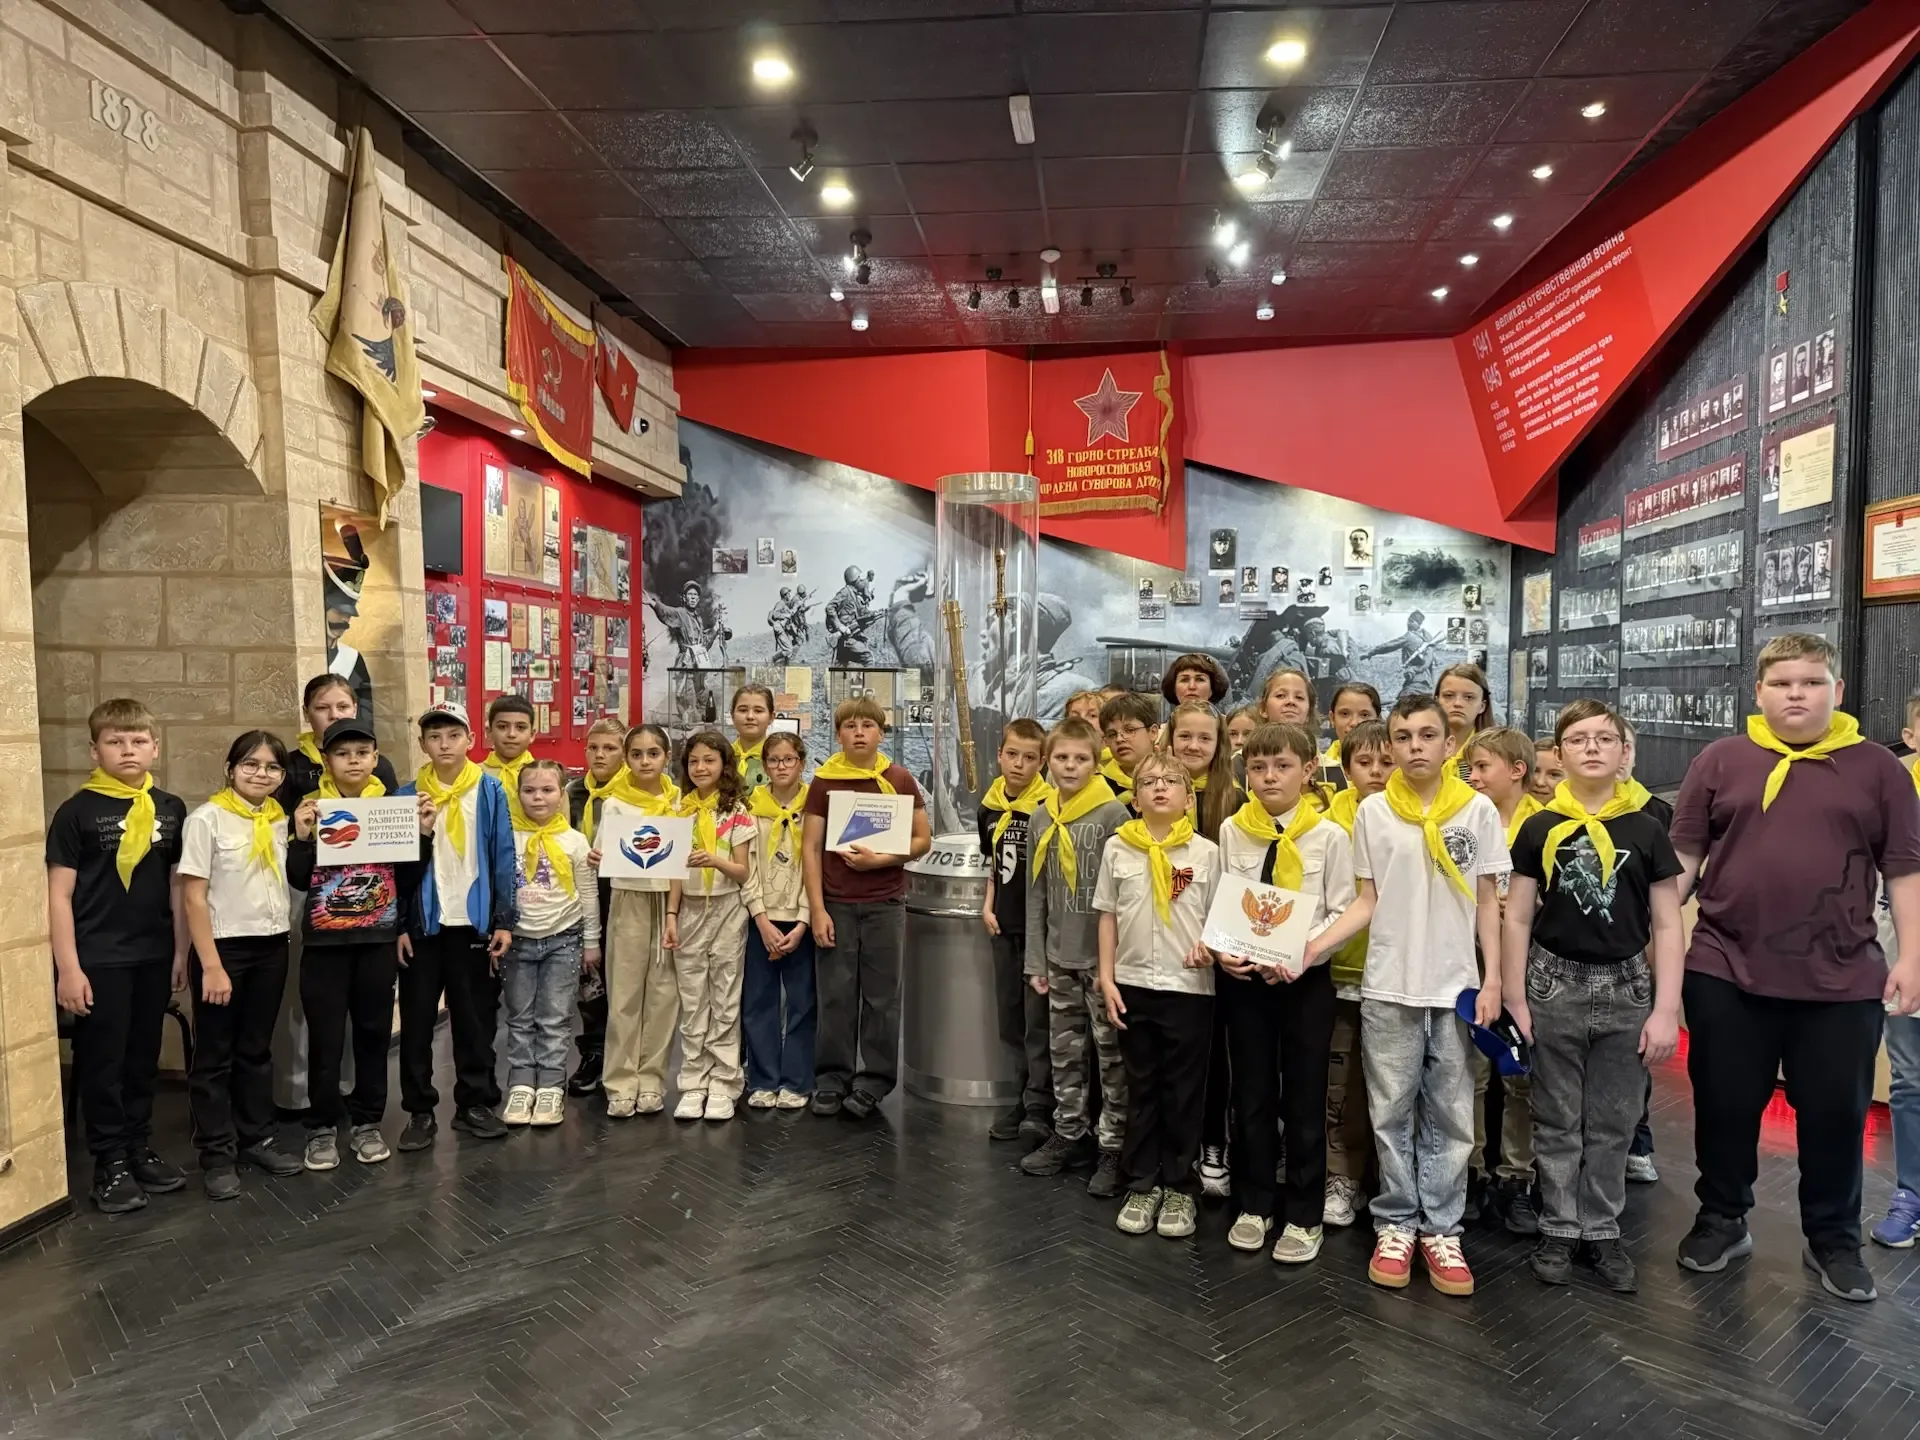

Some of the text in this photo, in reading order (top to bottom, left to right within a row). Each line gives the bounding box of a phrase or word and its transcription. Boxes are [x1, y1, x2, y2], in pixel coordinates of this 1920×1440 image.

[88, 80, 161, 153] 1828
[1526, 252, 1594, 308] отечественная
[1554, 287, 1571, 305] СССР
[1611, 245, 1633, 267] фронт
[1472, 329, 1493, 360] 1941
[1482, 361, 1503, 393] 1945
[1046, 448, 1065, 465] 318
[1066, 460, 1152, 479] НОВОРОССИЙСКАЯ
[1040, 480, 1078, 495] ОРДЕНА
[1081, 477, 1133, 491] СУВОРОВА
[367, 807, 415, 816] АГЕНТСТВО
[368, 816, 414, 824] РАЗВИТИЯ
[367, 824, 415, 832] ВНУТРЕННЕГО
[368, 831, 415, 841] ТУРИЗМА
[1070, 823, 1105, 849] STOP
